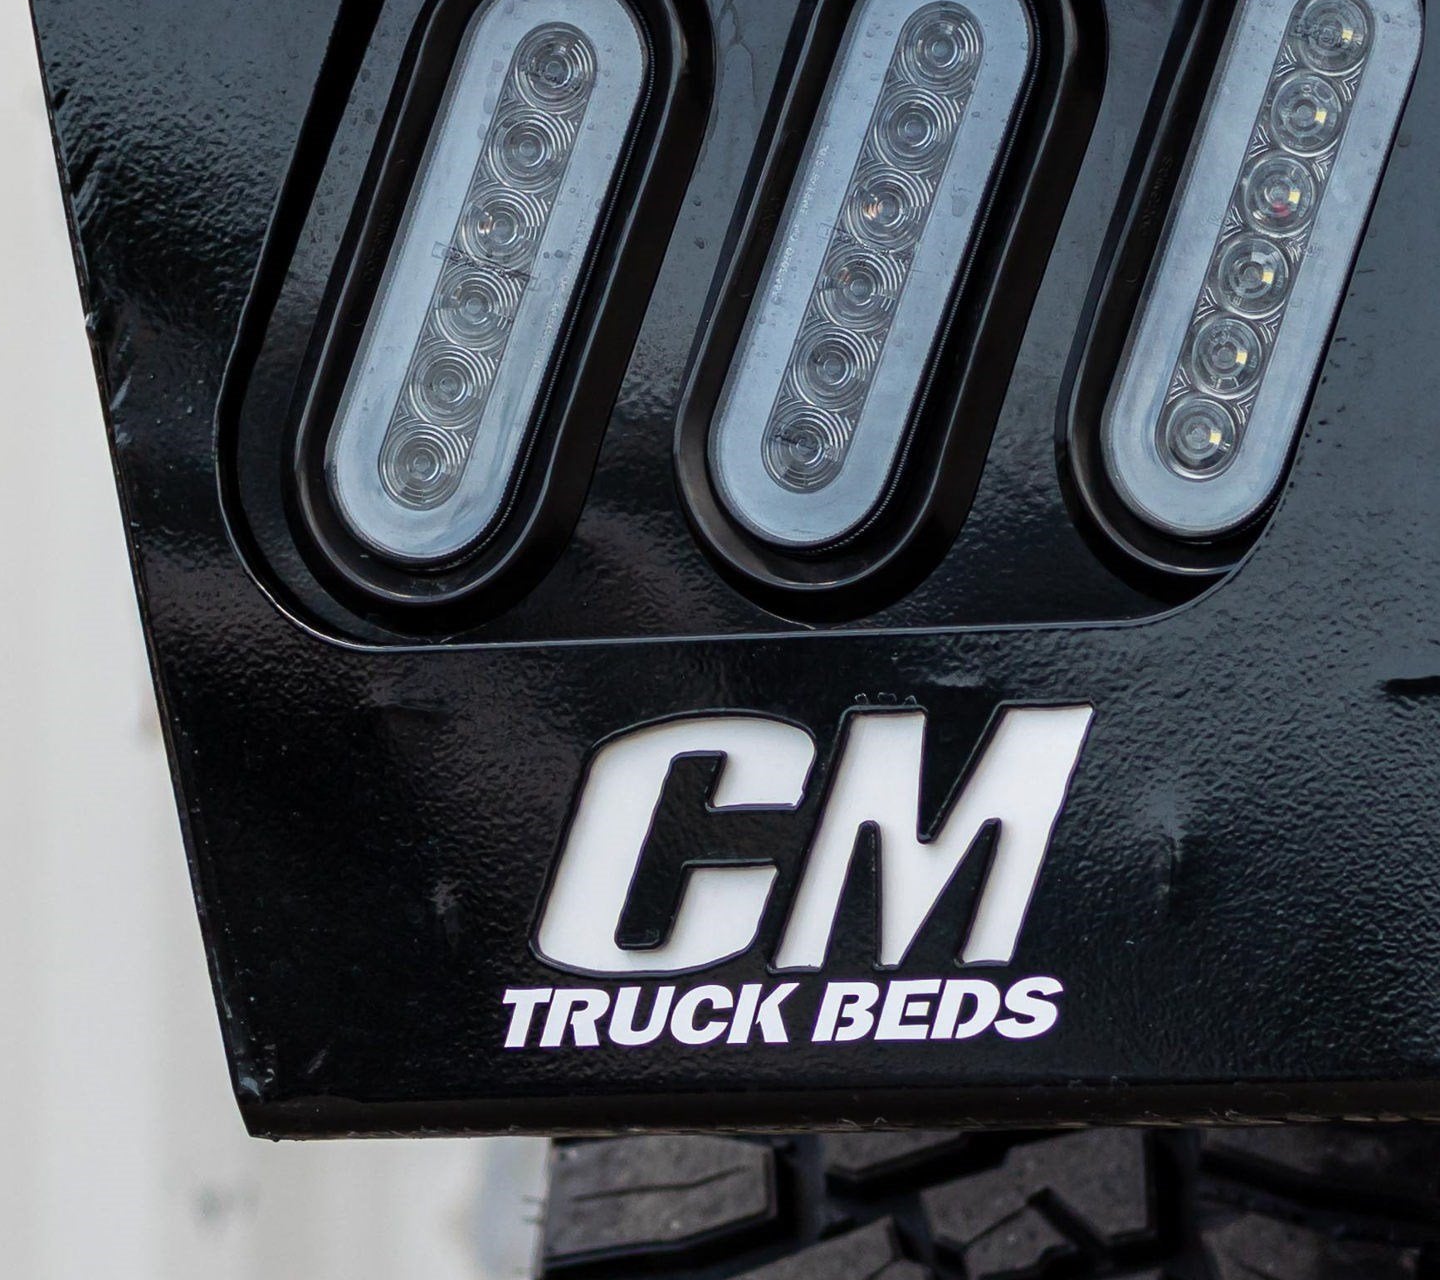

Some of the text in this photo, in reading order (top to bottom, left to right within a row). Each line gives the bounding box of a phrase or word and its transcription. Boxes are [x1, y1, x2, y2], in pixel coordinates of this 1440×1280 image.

[532, 701, 1095, 977] CM
[501, 976, 1064, 1049] TRUCK BEDS
